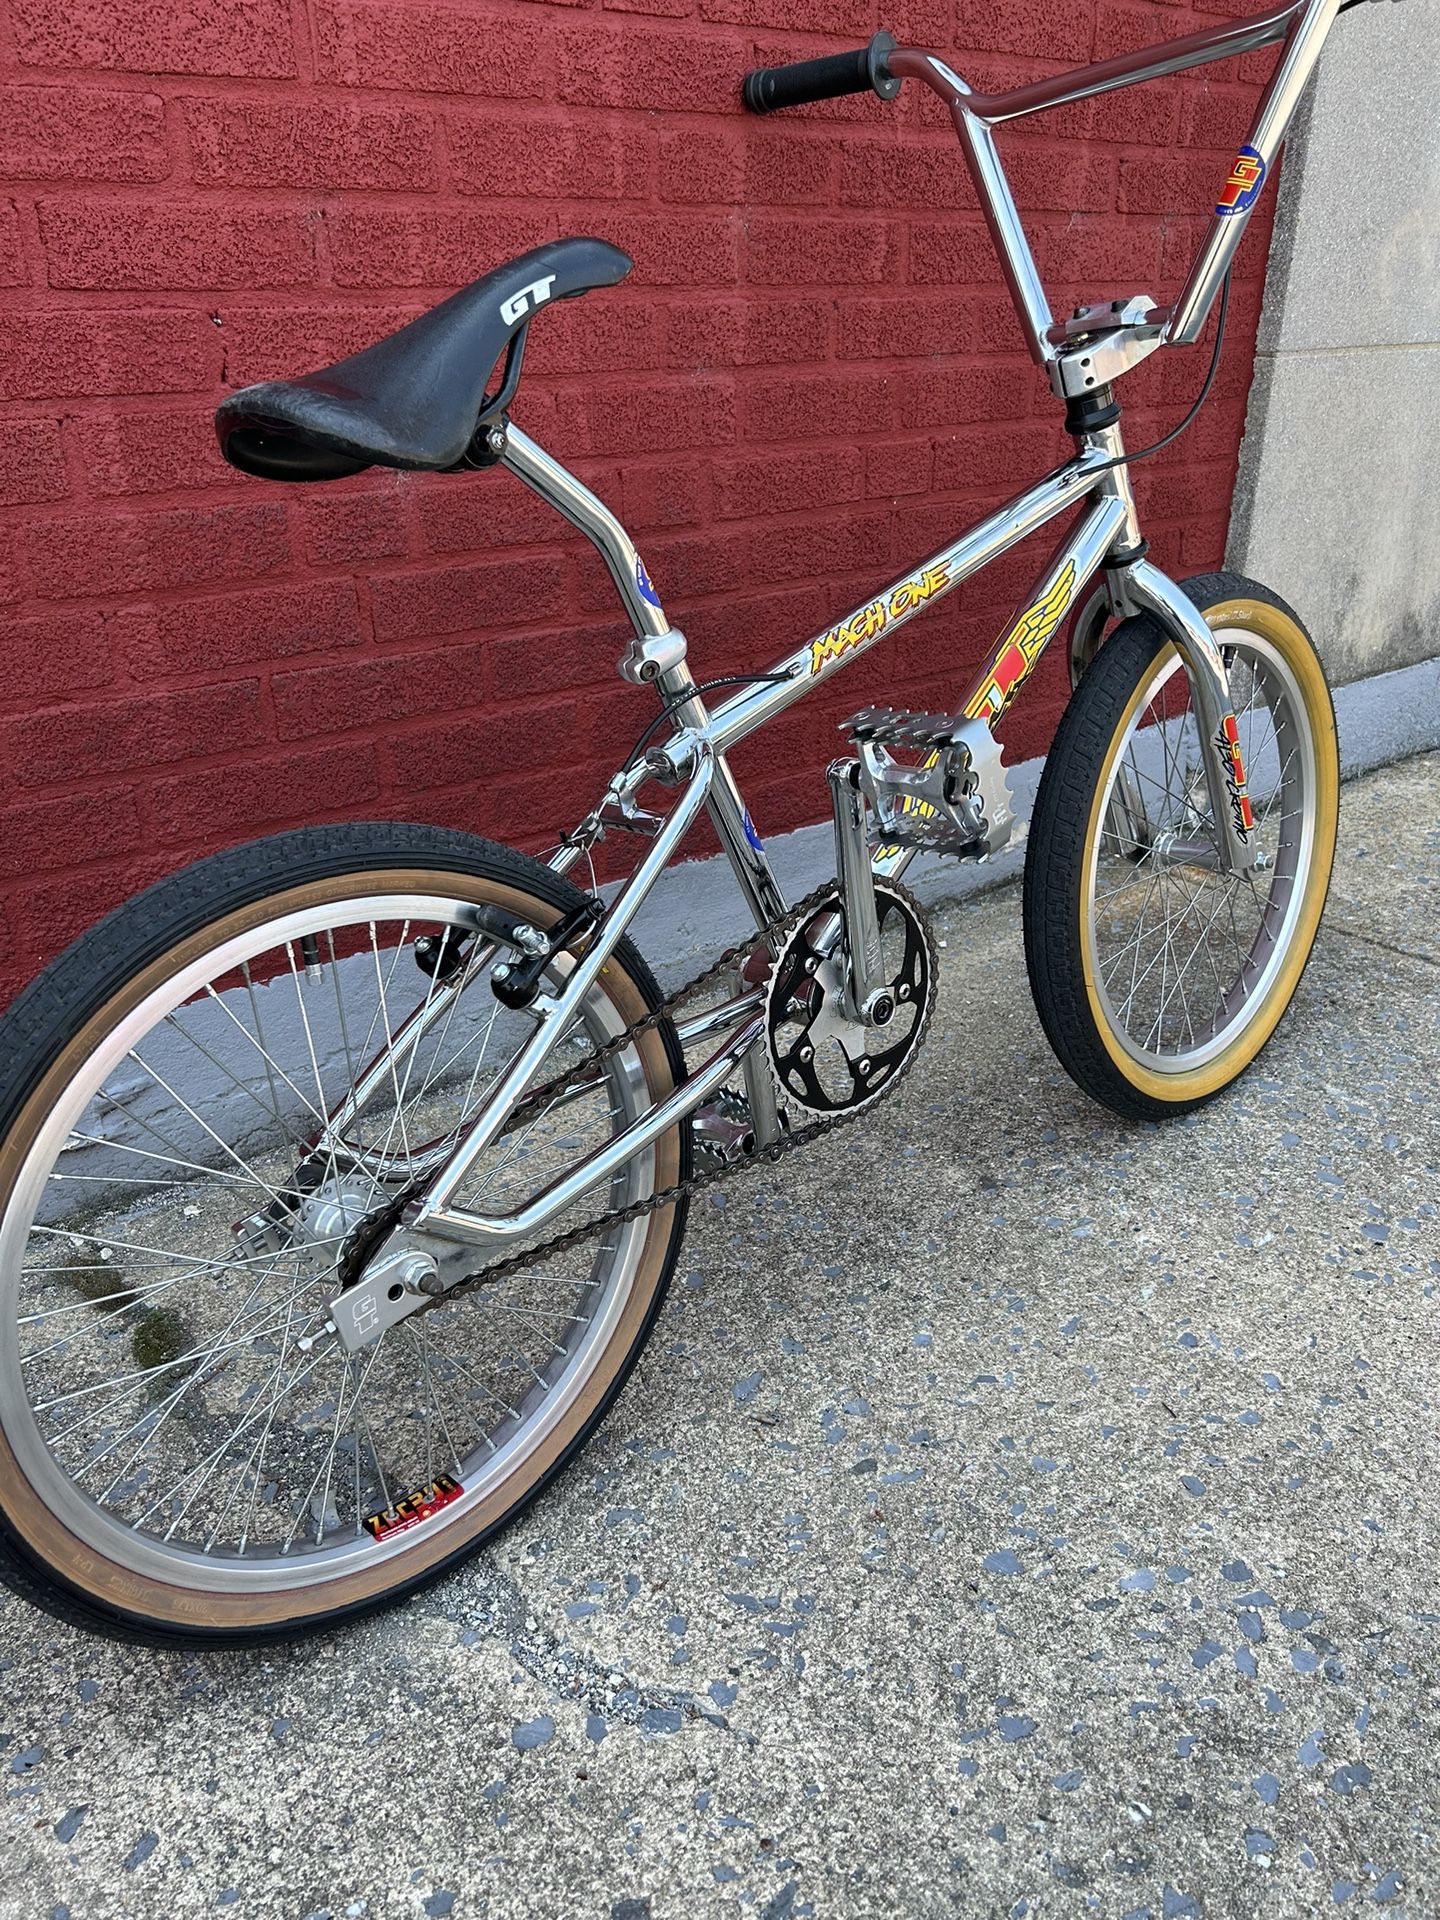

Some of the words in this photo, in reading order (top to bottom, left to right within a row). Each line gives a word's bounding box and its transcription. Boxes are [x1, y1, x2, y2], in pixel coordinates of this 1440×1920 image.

[500, 274, 556, 326] GT
[811, 600, 887, 676] MACH
[889, 560, 951, 618] ONE
